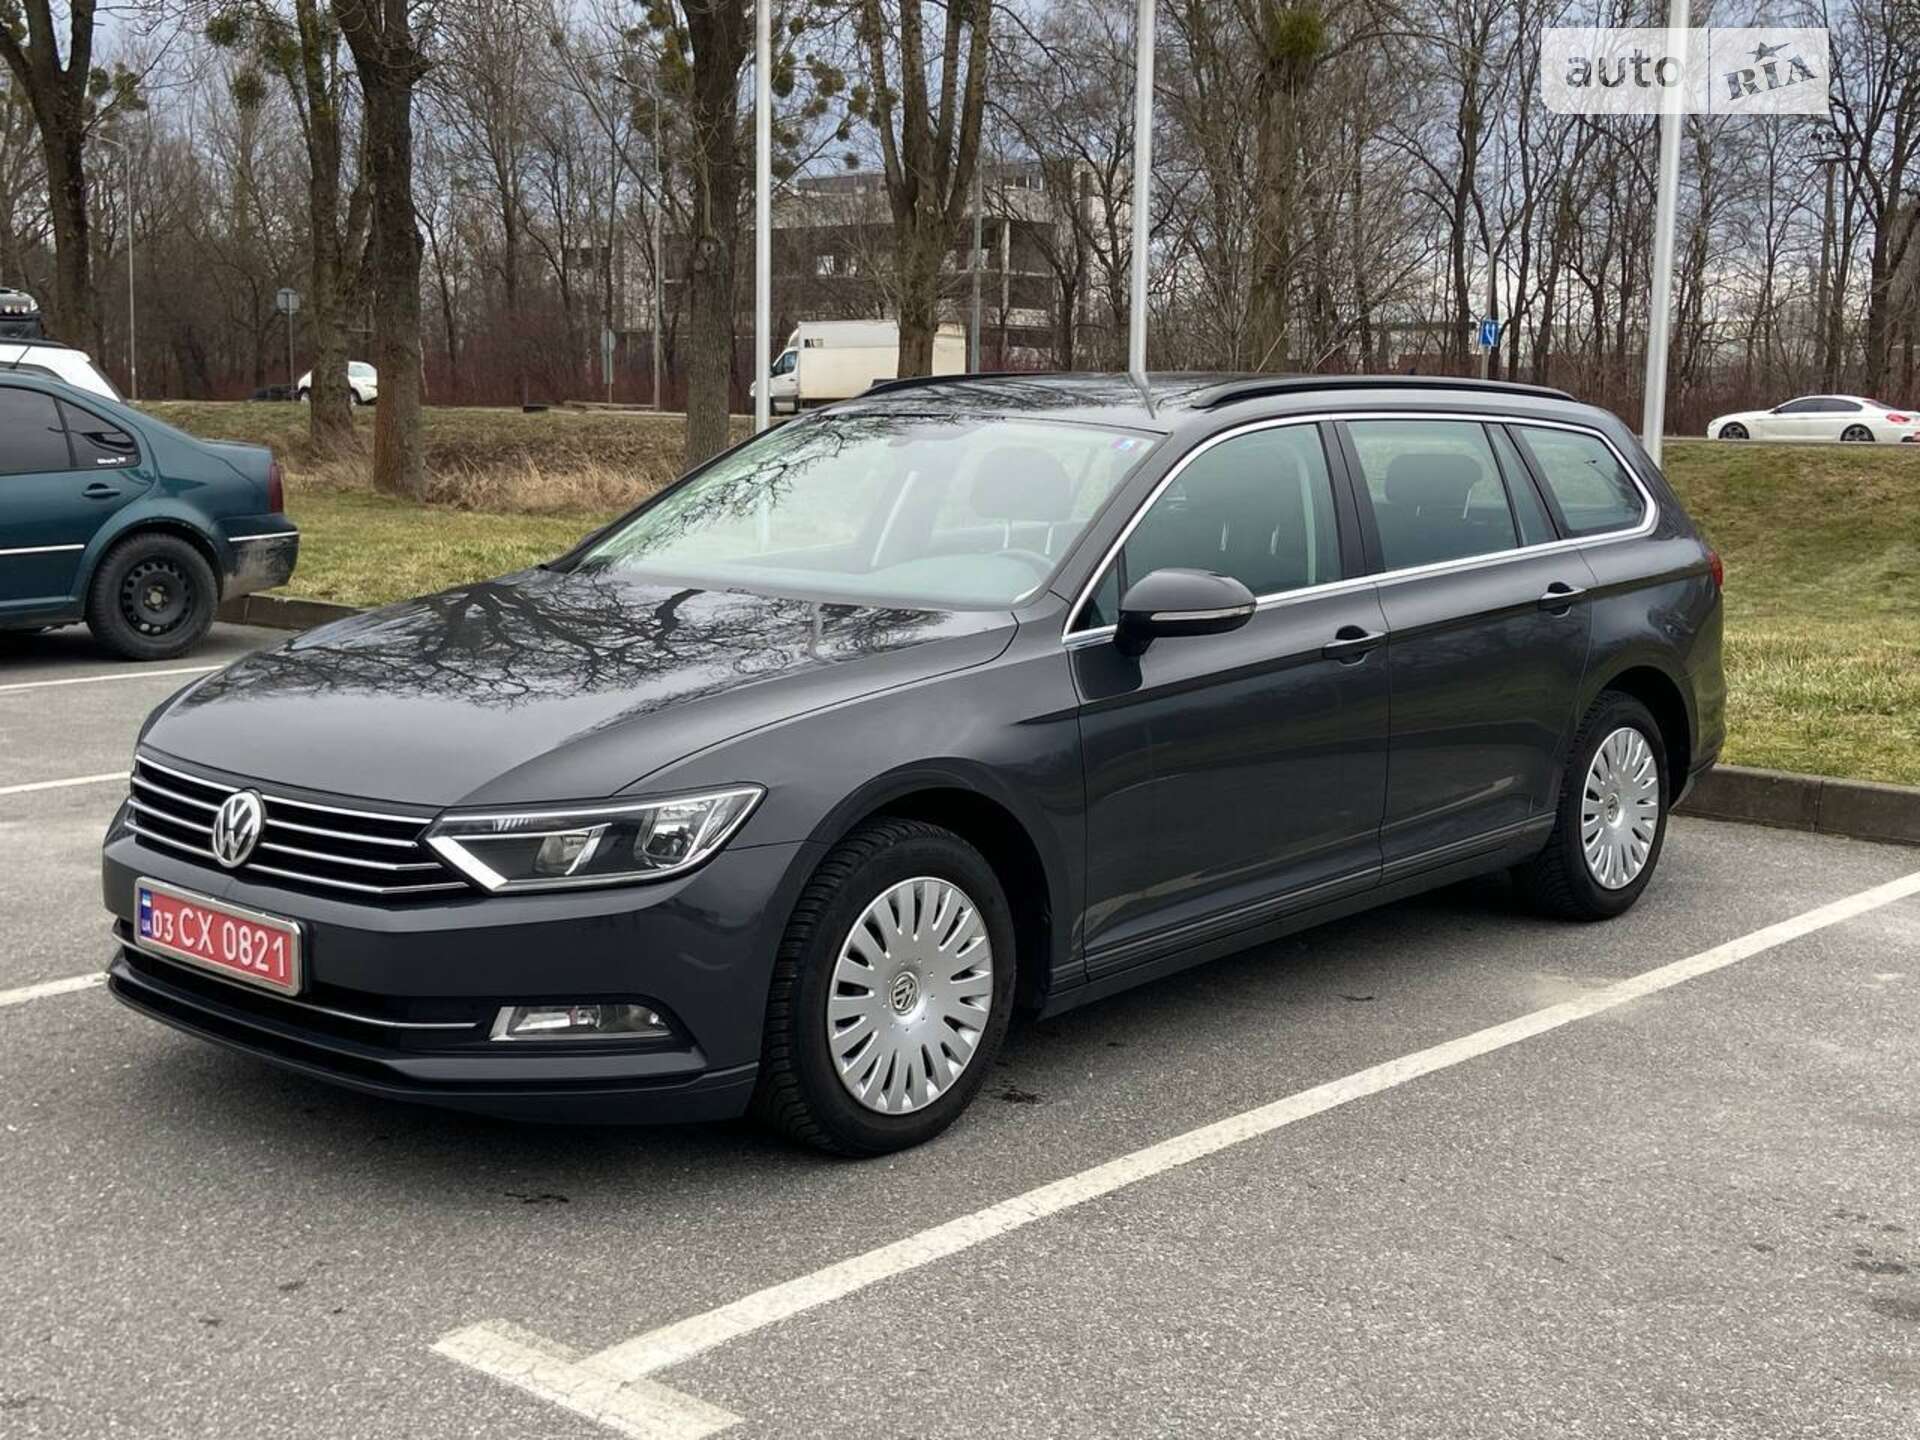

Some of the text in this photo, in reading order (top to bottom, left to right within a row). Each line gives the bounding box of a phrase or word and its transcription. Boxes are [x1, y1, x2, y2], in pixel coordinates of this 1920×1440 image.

[152, 907, 286, 977] 03 CX 0821
